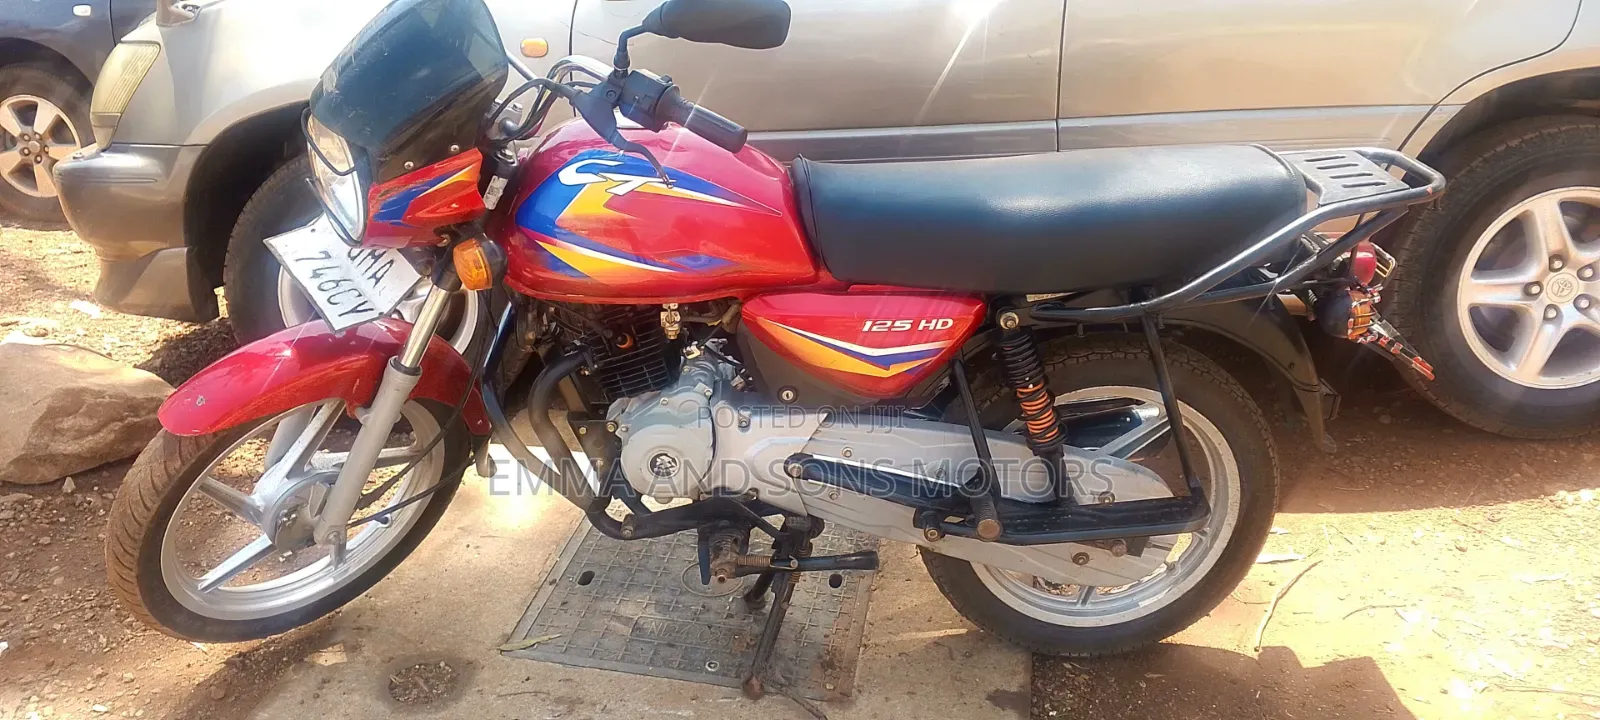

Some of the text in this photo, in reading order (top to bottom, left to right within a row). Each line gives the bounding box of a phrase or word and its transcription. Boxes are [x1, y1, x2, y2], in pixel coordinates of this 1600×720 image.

[558, 159, 677, 196] CT
[295, 250, 374, 317] 746CY
[862, 318, 954, 332] 125 HD
